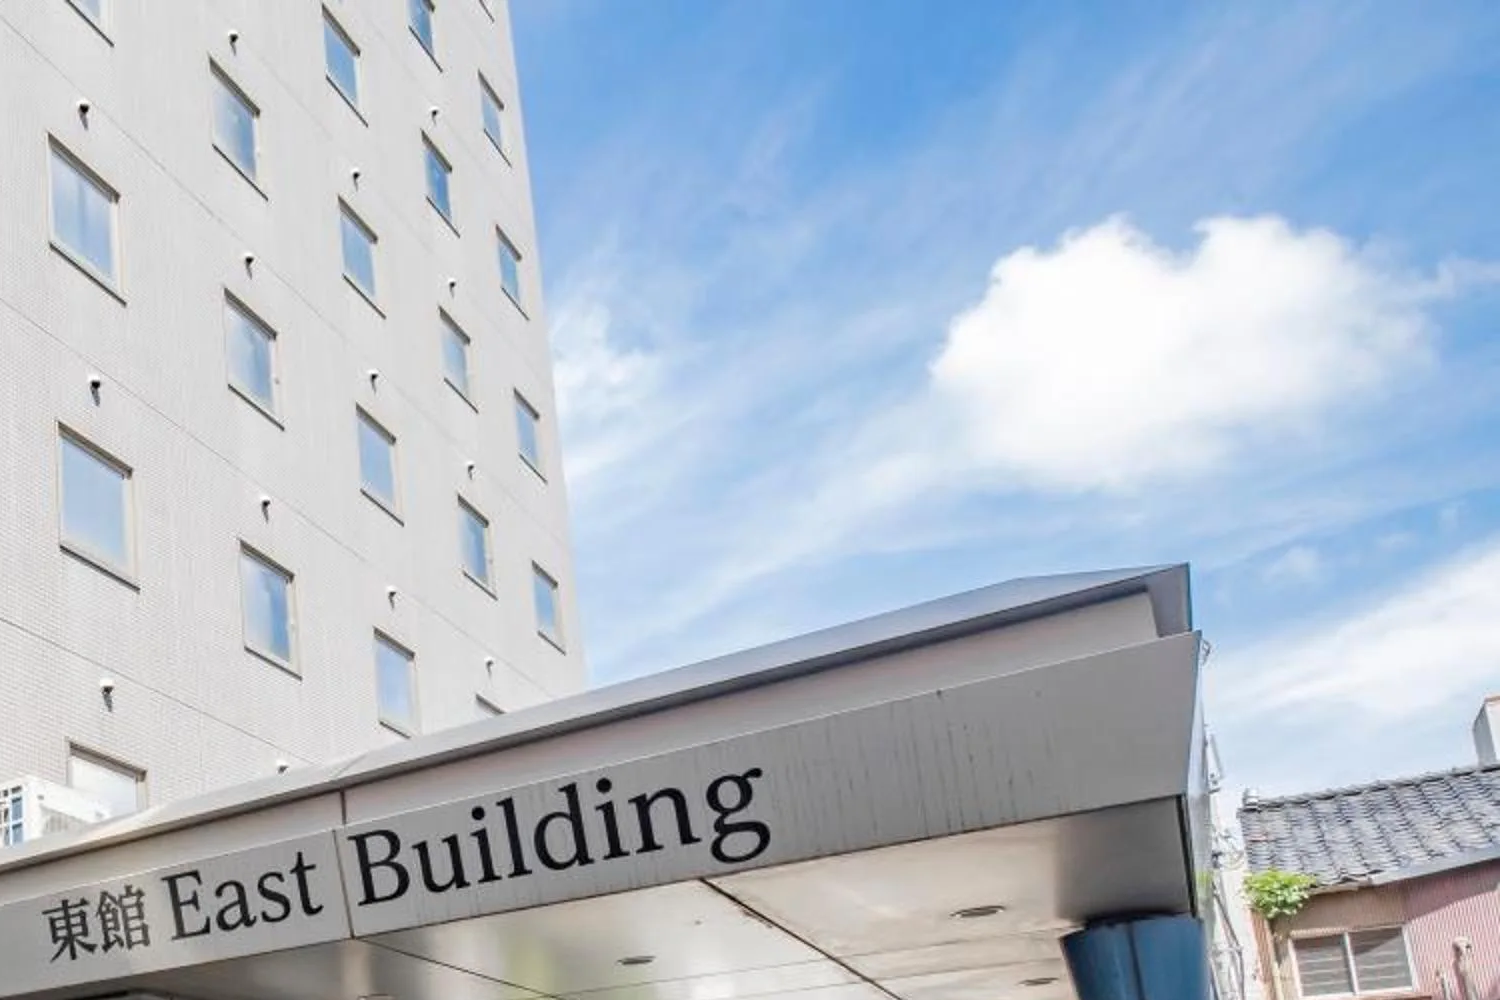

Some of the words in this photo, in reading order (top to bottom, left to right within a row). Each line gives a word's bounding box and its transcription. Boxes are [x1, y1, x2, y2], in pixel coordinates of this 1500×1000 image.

[42, 884, 151, 961] 東館
[161, 850, 325, 940] East
[347, 767, 772, 907] Building
